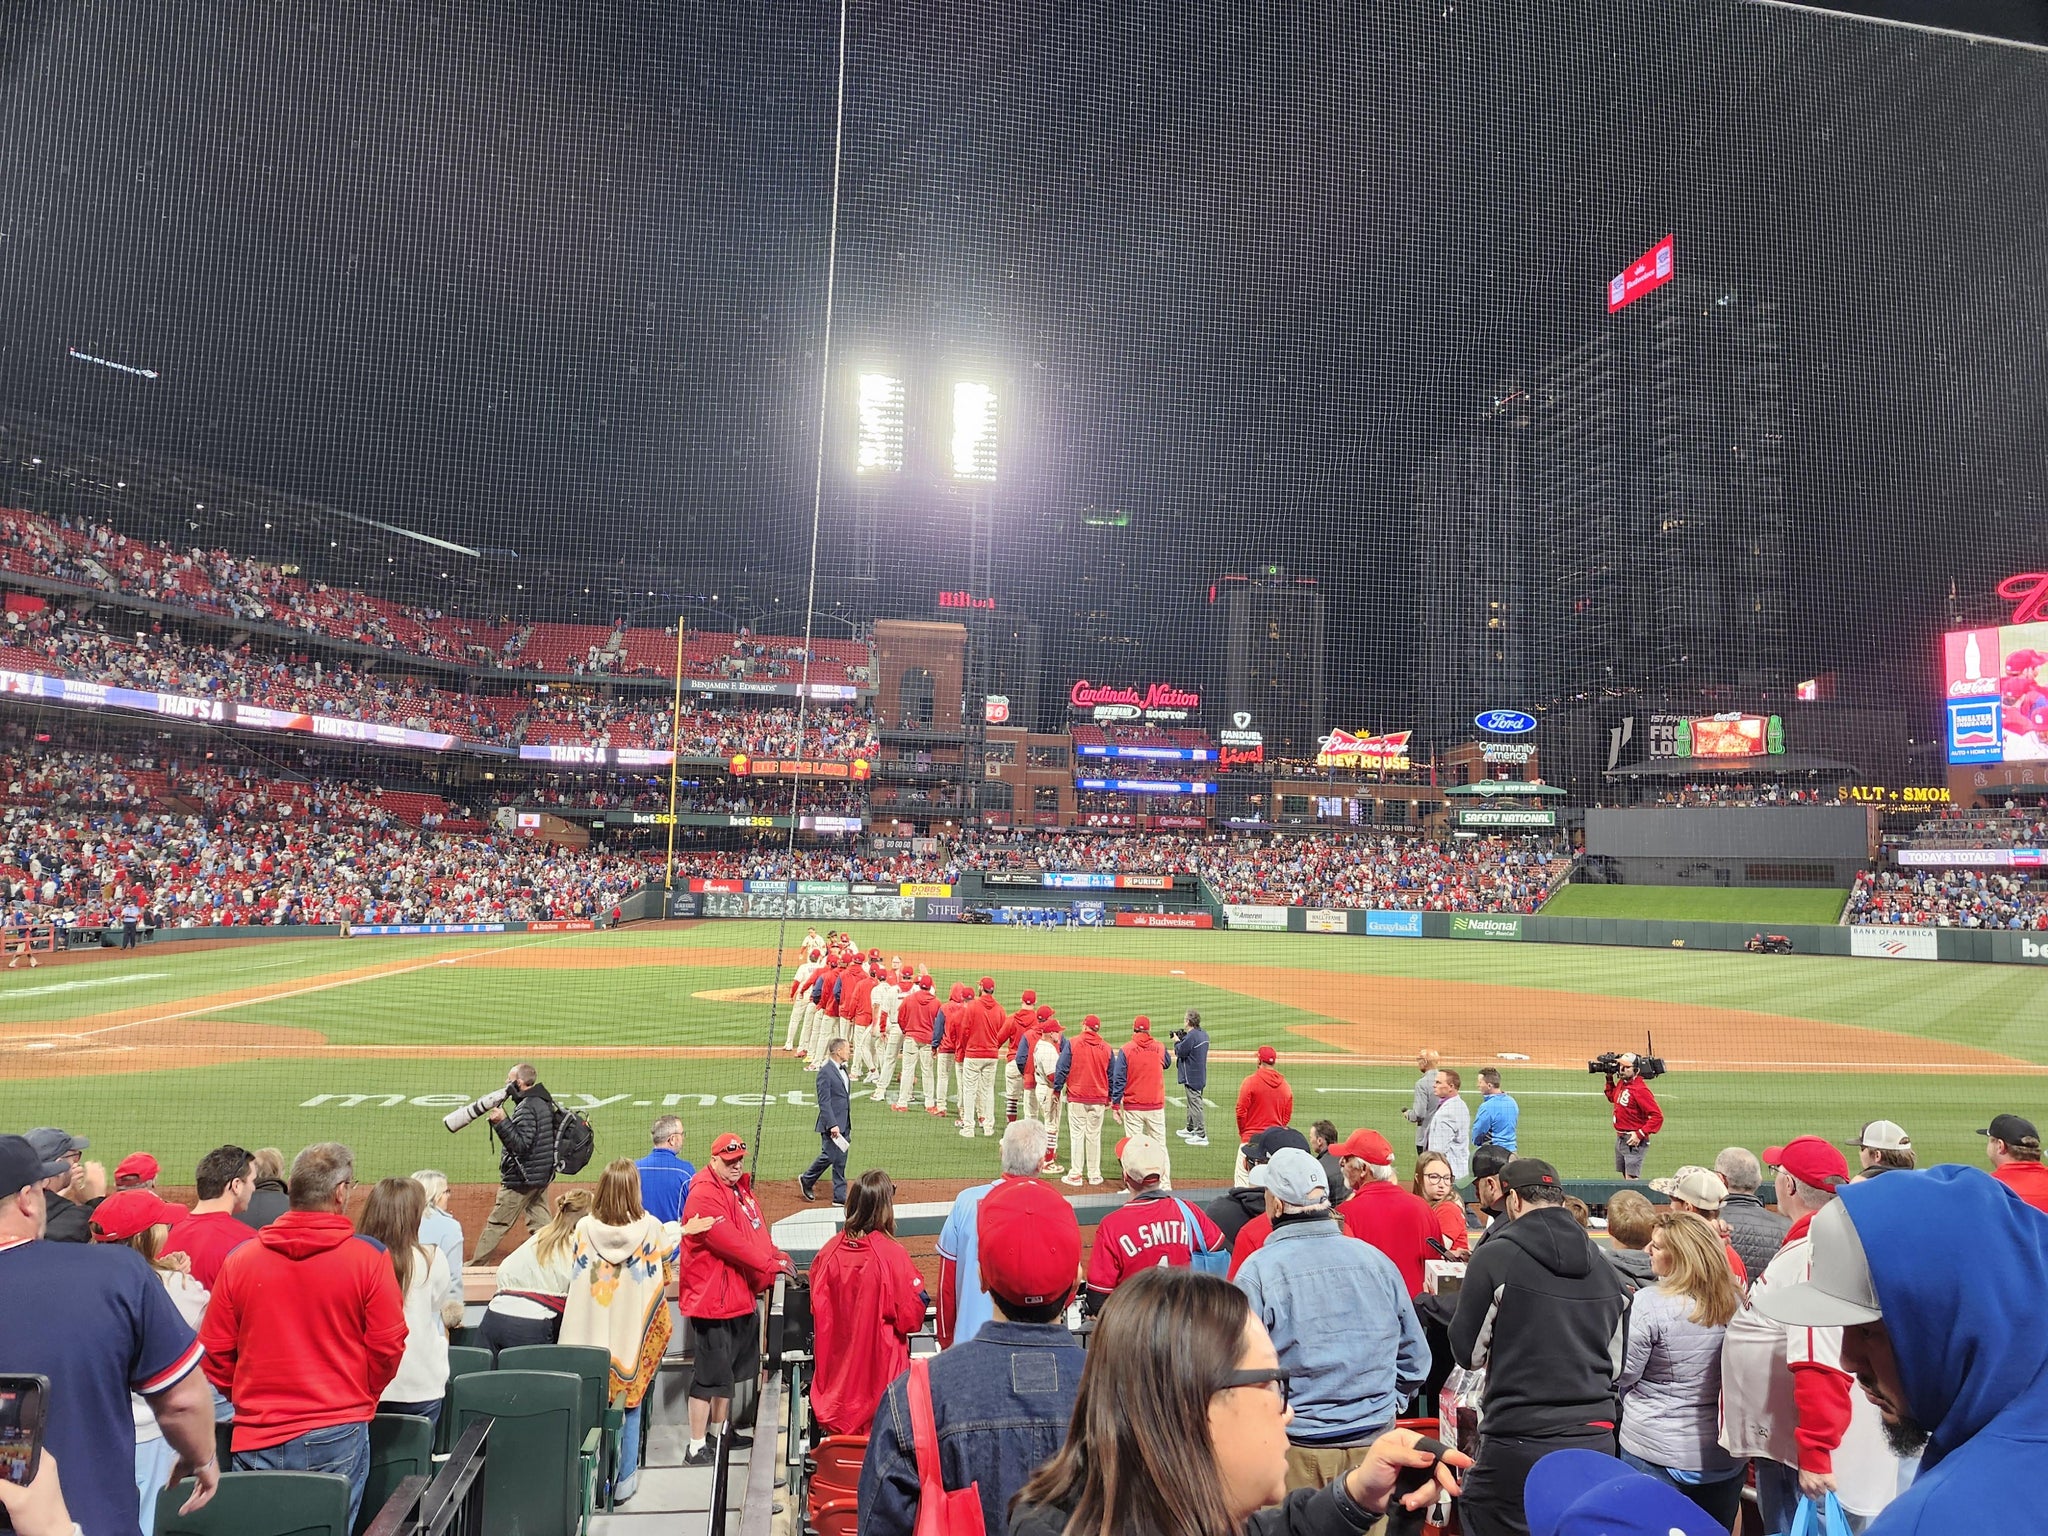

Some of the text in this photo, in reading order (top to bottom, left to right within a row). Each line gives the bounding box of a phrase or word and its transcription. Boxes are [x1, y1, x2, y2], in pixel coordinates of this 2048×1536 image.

[691, 680, 730, 690] BENJAMIN
[739, 683, 776, 692] EDWARDS
[1071, 680, 1199, 708] Cardinals Nation
[157, 694, 223, 720] THAT'S A
[1487, 712, 1525, 729] Ford
[312, 716, 354, 738] THAT'S
[355, 722, 366, 740] A
[1221, 730, 1263, 740] FANDUEL
[1317, 736, 1409, 753] Budweiser
[1479, 742, 1537, 755] Community
[550, 746, 595, 763] THAT'S
[595, 748, 607, 763] A
[1220, 745, 1263, 764] Live!
[752, 761, 848, 777] BIG MAC LAND
[1360, 756, 1411, 770] HOUSE
[1838, 786, 1885, 802] SALT
[730, 815, 773, 827] bet365
[1464, 814, 1550, 824] SAFETY NATIONAL
[1404, 825, 1416, 833] YOU
[1908, 852, 1996, 863] TODAY'S TOTALS
[1132, 877, 1162, 886] PURINA
[807, 884, 830, 892] Central
[831, 885, 848, 893] Bank
[911, 885, 942, 893] DOBBS
[927, 903, 960, 916] STIFEL
[1075, 900, 1102, 908] CarShield
[1238, 911, 1262, 919] Ameren
[1148, 916, 1196, 927] Budweiser
[1468, 919, 1517, 931] National
